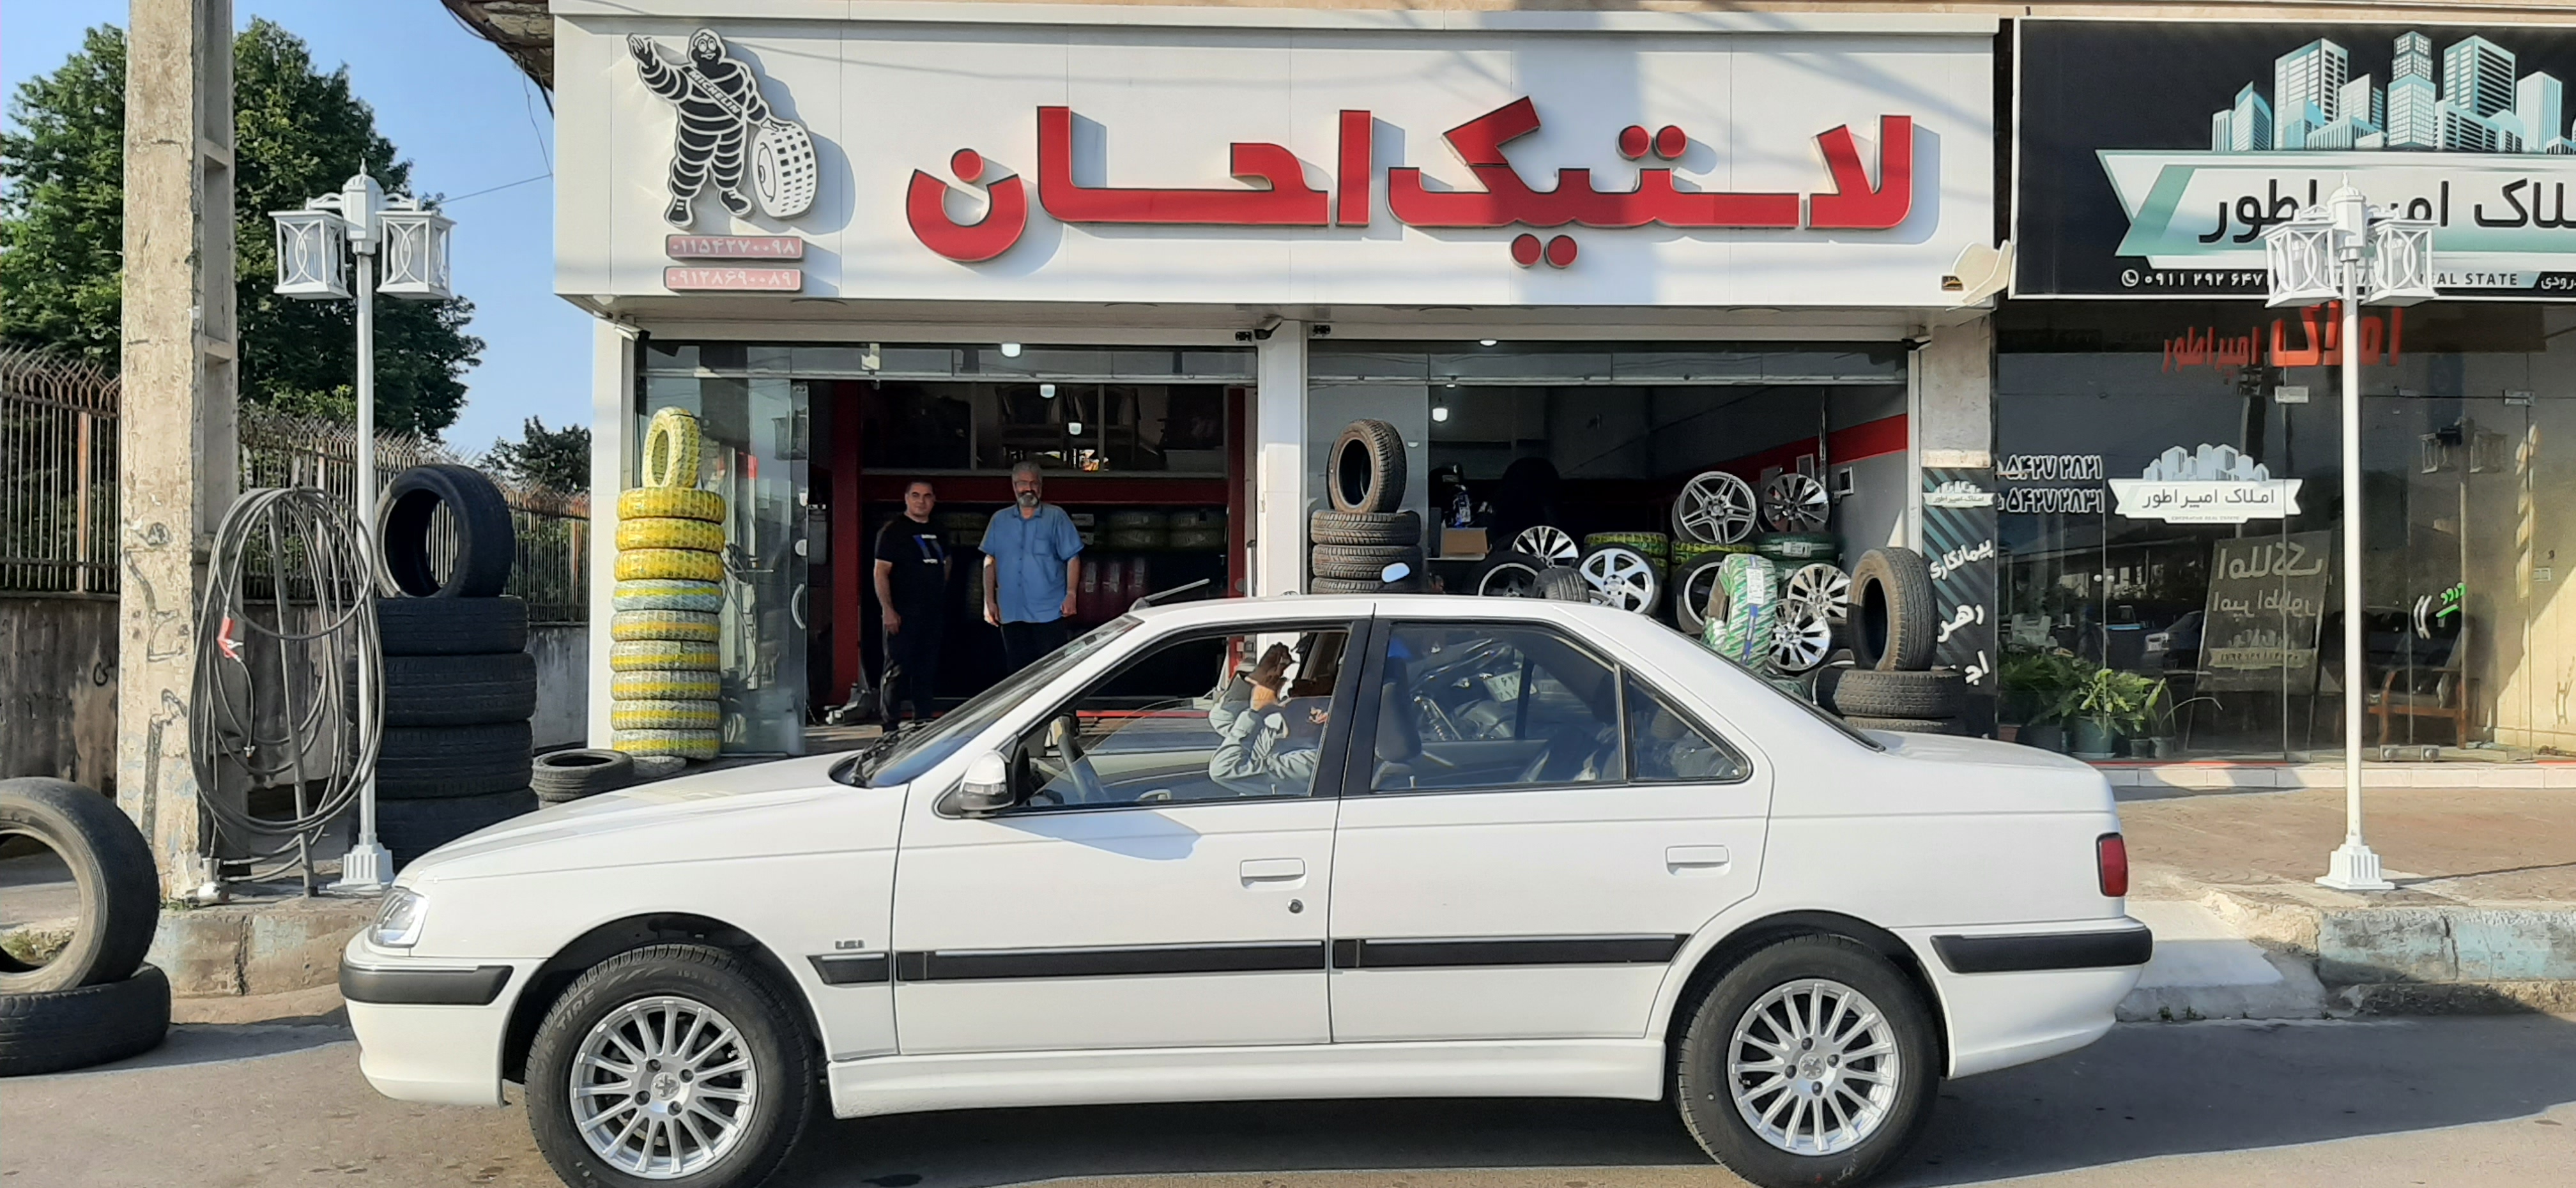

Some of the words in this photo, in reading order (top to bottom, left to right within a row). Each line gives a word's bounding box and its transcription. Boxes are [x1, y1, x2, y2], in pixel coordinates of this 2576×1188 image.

[688, 70, 740, 114] MICHELIN
[1388, 95, 1912, 268] لاستیک
[2474, 178, 2576, 228] لاک
[2231, 273, 2269, 287] ۶۴۷
[2465, 273, 2517, 286] STATE
[2006, 487, 2057, 513] ۵۴۲۷
[2225, 488, 2274, 503] املاک
[1930, 540, 1994, 580] پیمانکاری
[556, 989, 595, 1031] TIRE
